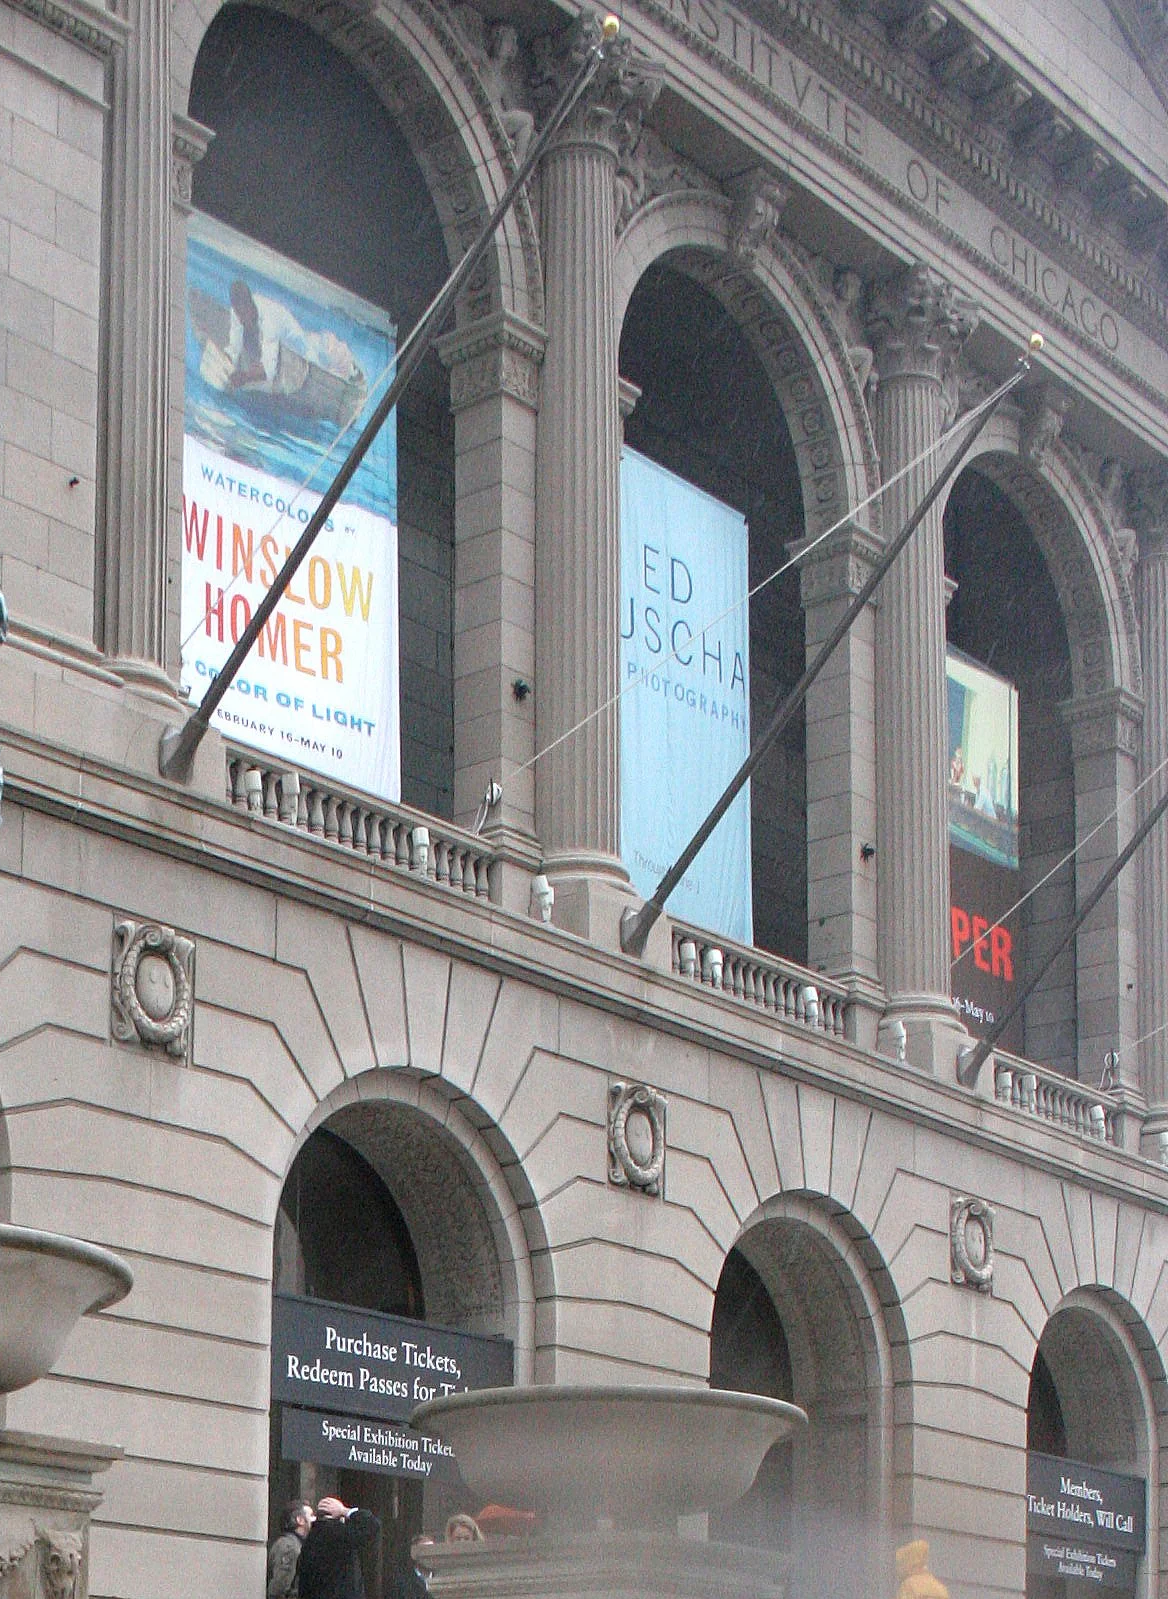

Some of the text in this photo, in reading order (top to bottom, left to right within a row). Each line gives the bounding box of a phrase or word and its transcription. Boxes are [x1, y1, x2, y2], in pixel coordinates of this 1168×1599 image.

[907, 159, 951, 216] OF
[990, 225, 1119, 351] CHICAGO
[200, 462, 336, 533] WATERCOLOS
[183, 493, 374, 622] WINSLOW
[643, 543, 693, 604] ED
[205, 580, 344, 684] HOMER
[216, 708, 275, 737] EBRUARY
[331, 747, 344, 761] 10
[276, 692, 305, 713] OF
[311, 703, 377, 738] LIGHT
[287, 1355, 354, 1388] Redeem
[359, 1367, 408, 1399] Passes
[413, 1376, 436, 1401] for
[325, 1326, 461, 1379] Purchase Tickets,
[321, 1420, 361, 1442] Special
[363, 1427, 419, 1452] Exhibition
[348, 1445, 433, 1476] Available Today
[1027, 1494, 1134, 1534] Ticket Holders, Will Call
[1059, 1476, 1103, 1505] Members,
